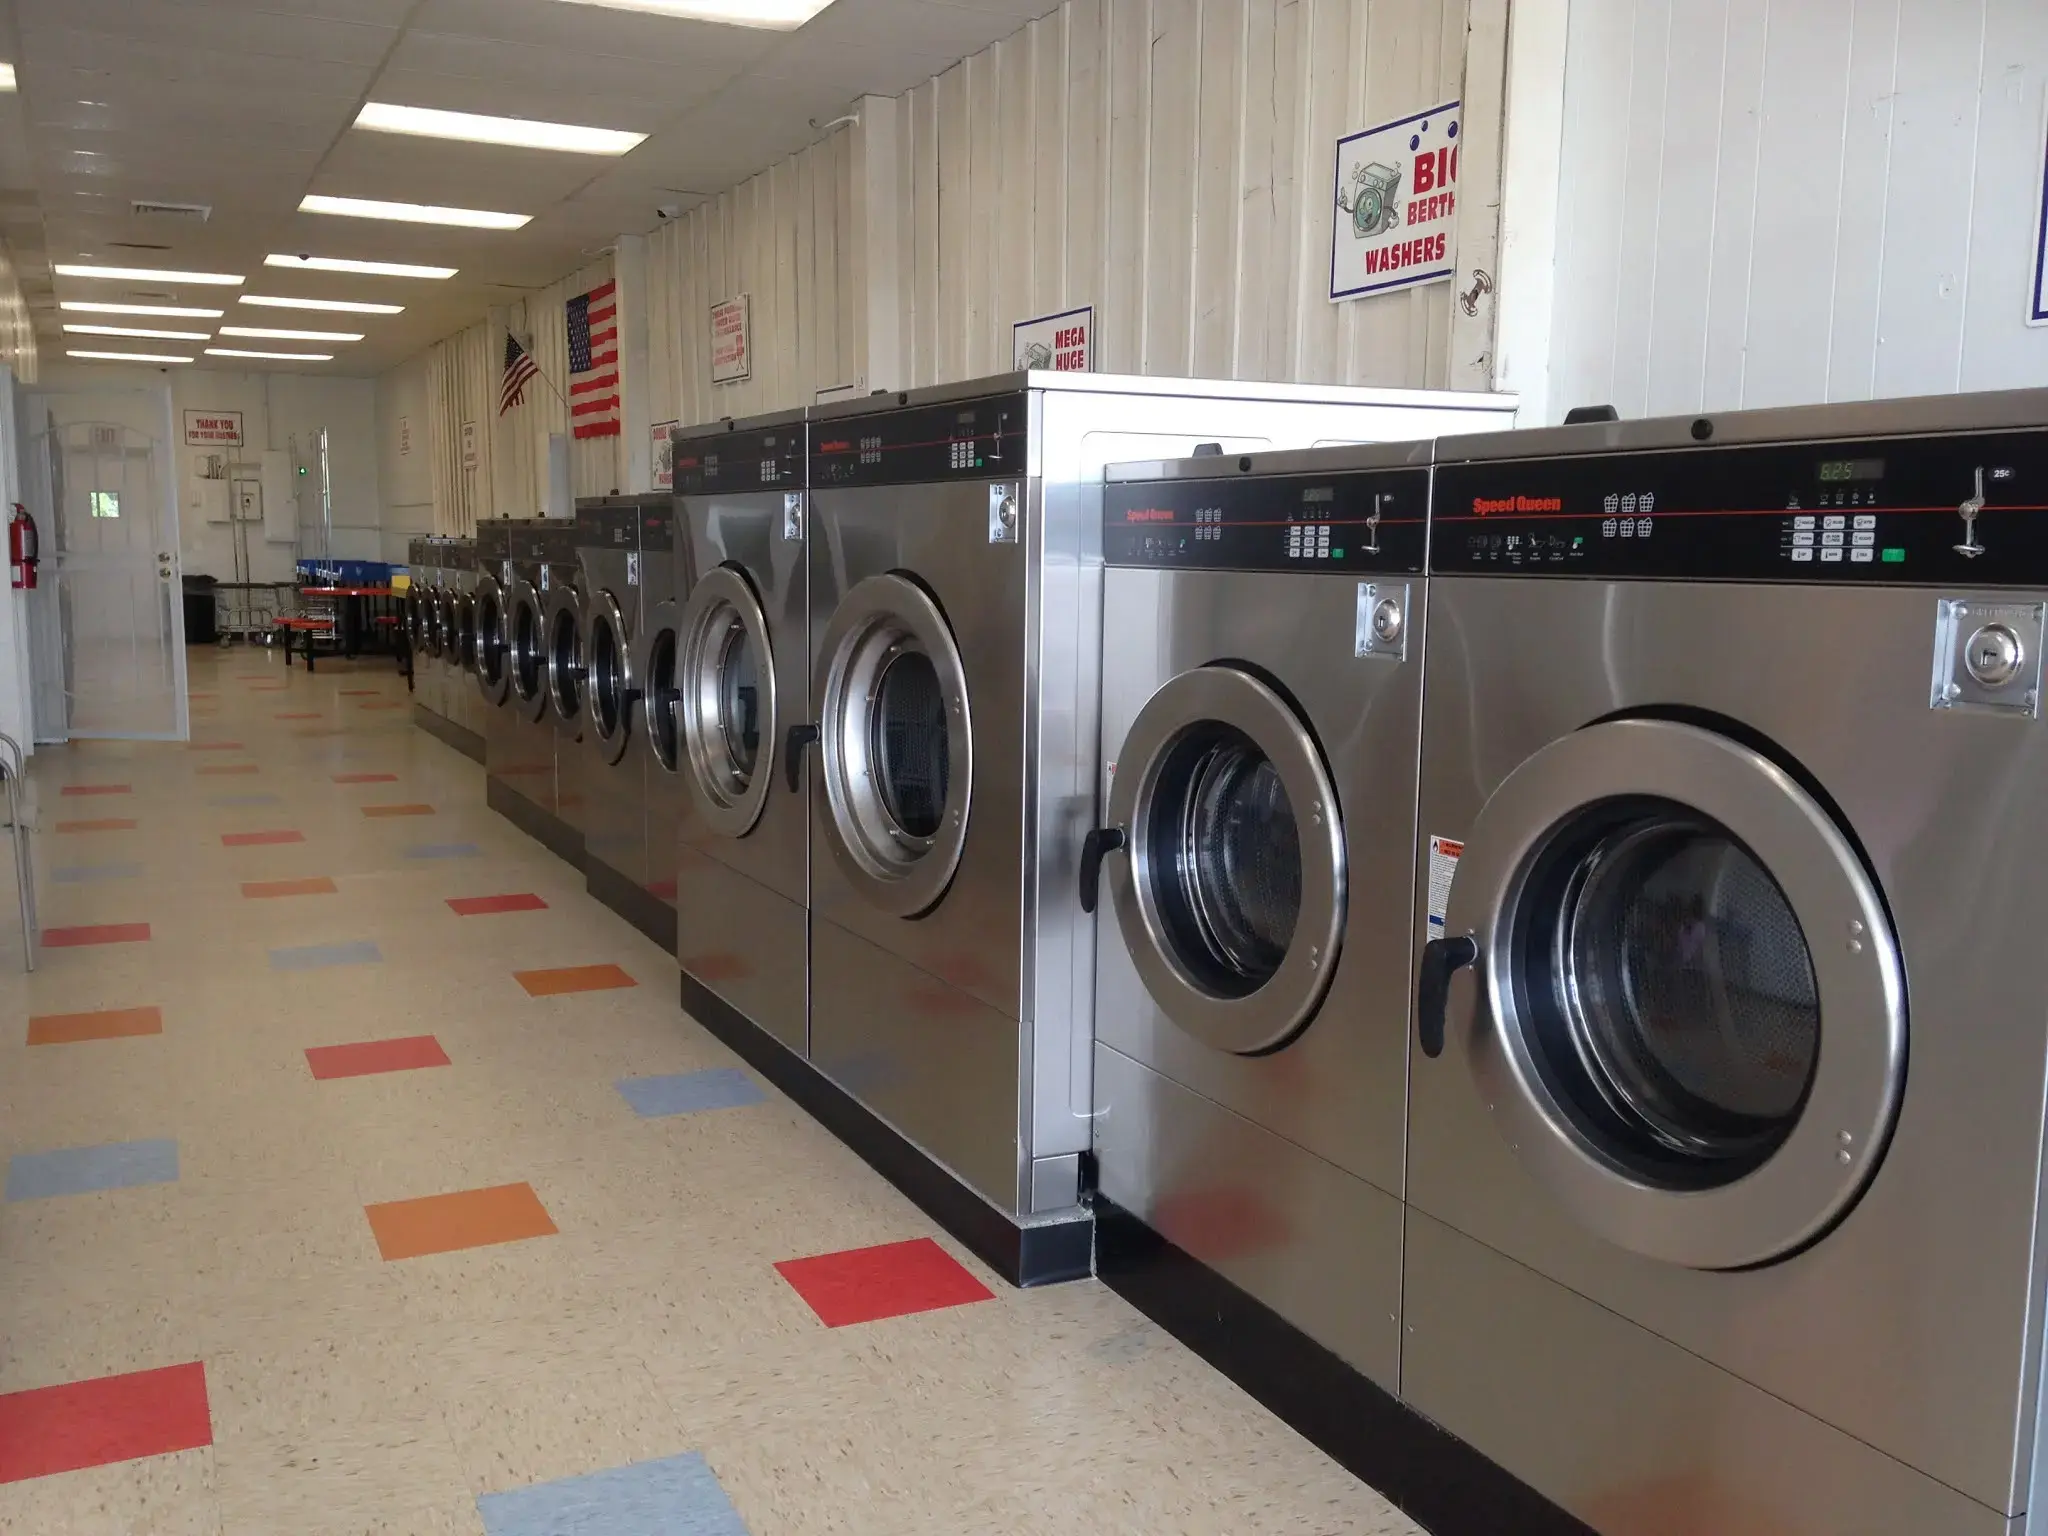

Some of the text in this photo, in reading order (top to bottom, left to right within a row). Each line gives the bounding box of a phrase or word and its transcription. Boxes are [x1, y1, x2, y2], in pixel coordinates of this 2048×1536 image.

[1365, 233, 1446, 275] WASHERS
[1055, 326, 1086, 349] MEGA
[1056, 350, 1084, 371] HUGE
[196, 418, 234, 431] THANK YOU
[1473, 495, 1561, 515] Speed Queen
